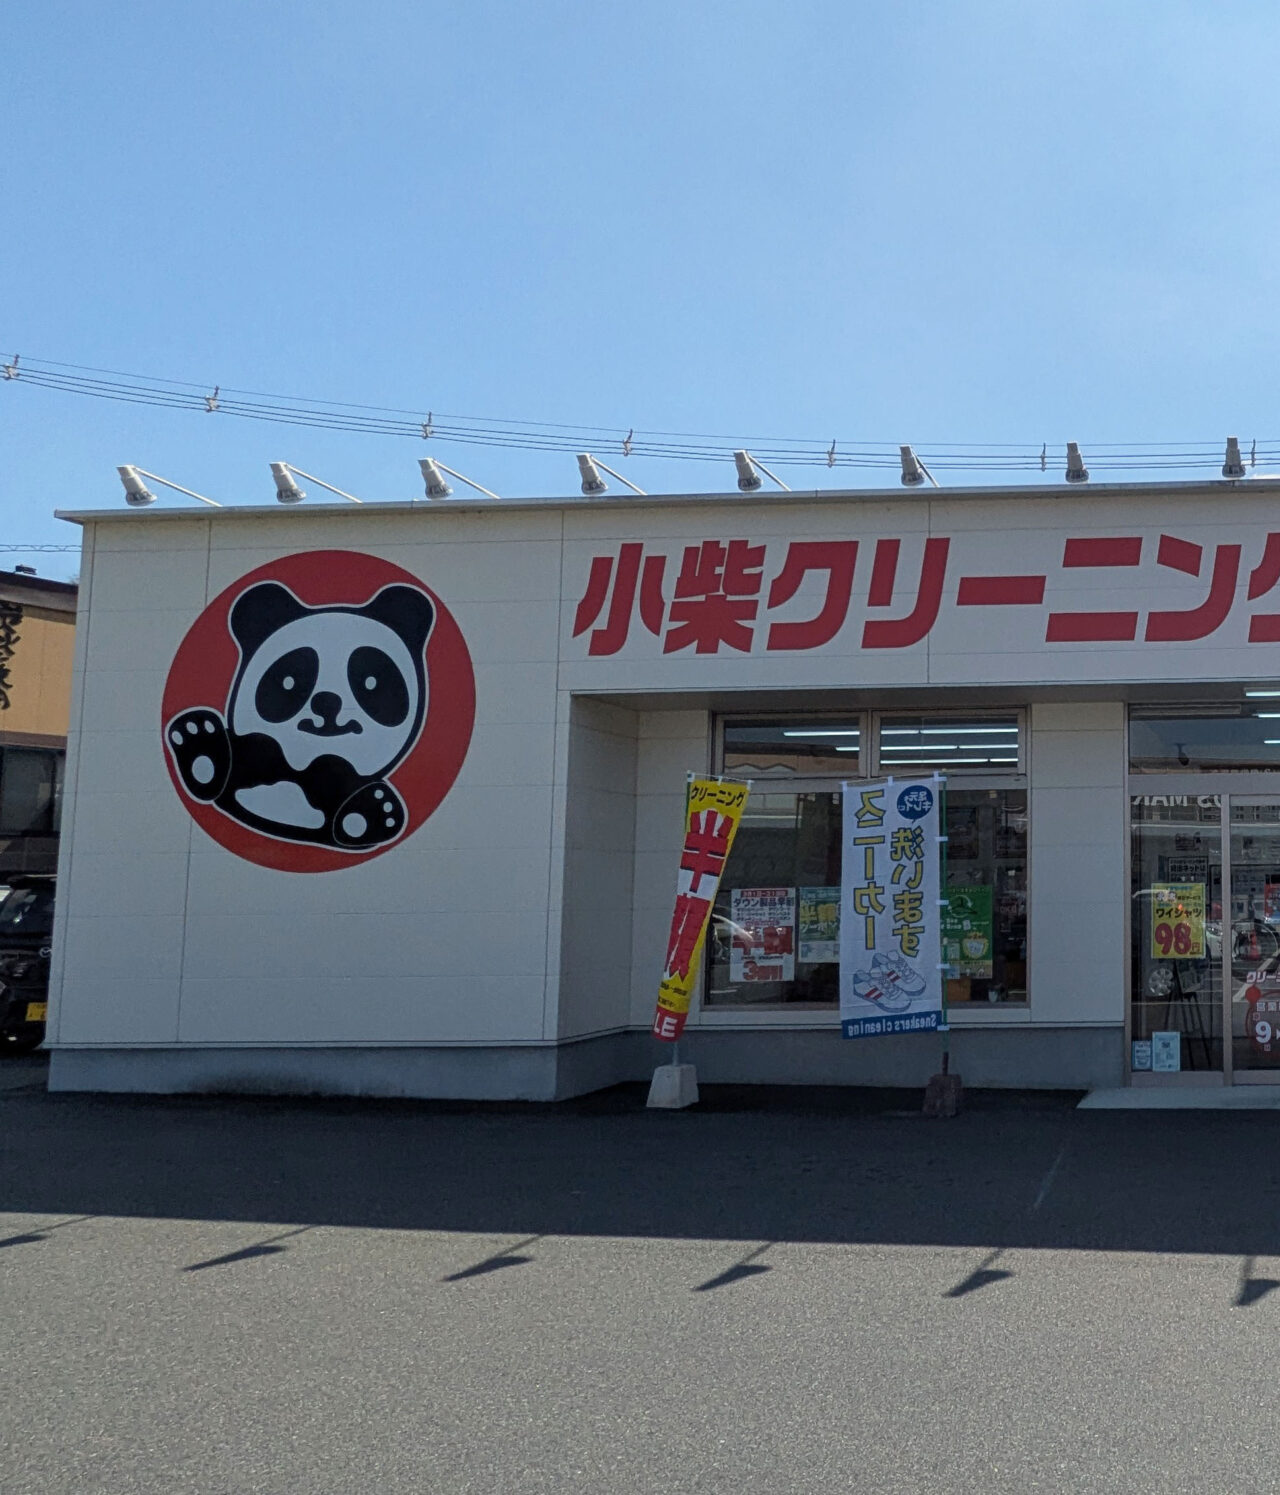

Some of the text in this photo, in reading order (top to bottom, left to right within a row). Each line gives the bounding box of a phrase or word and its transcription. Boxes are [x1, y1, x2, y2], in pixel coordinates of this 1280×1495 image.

[691, 786, 745, 808] クリーニング
[1155, 907, 1202, 918] ワイシャツ
[1255, 1021, 1272, 1044] 9
